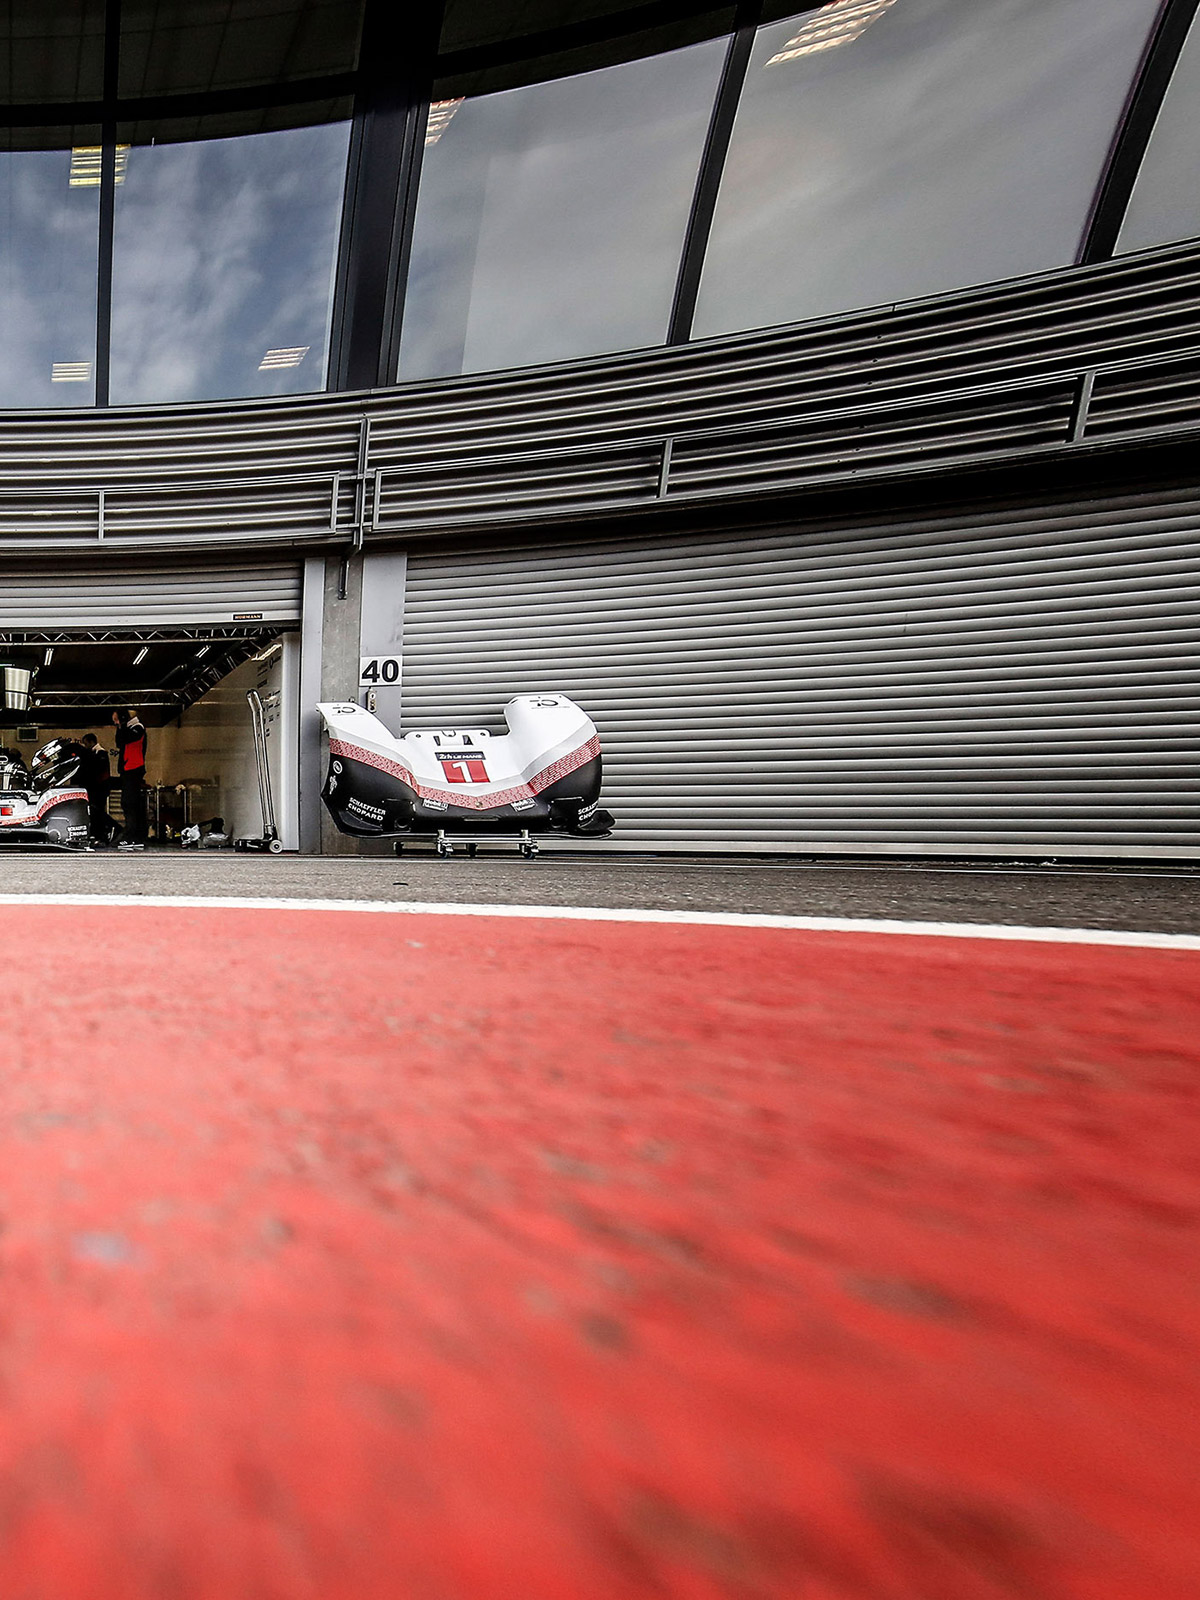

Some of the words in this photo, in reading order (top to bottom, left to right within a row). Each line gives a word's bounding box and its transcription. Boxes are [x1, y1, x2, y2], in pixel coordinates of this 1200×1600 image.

[361, 660, 399, 683] 40
[452, 761, 473, 783] 1
[348, 803, 383, 820] CHOPARD
